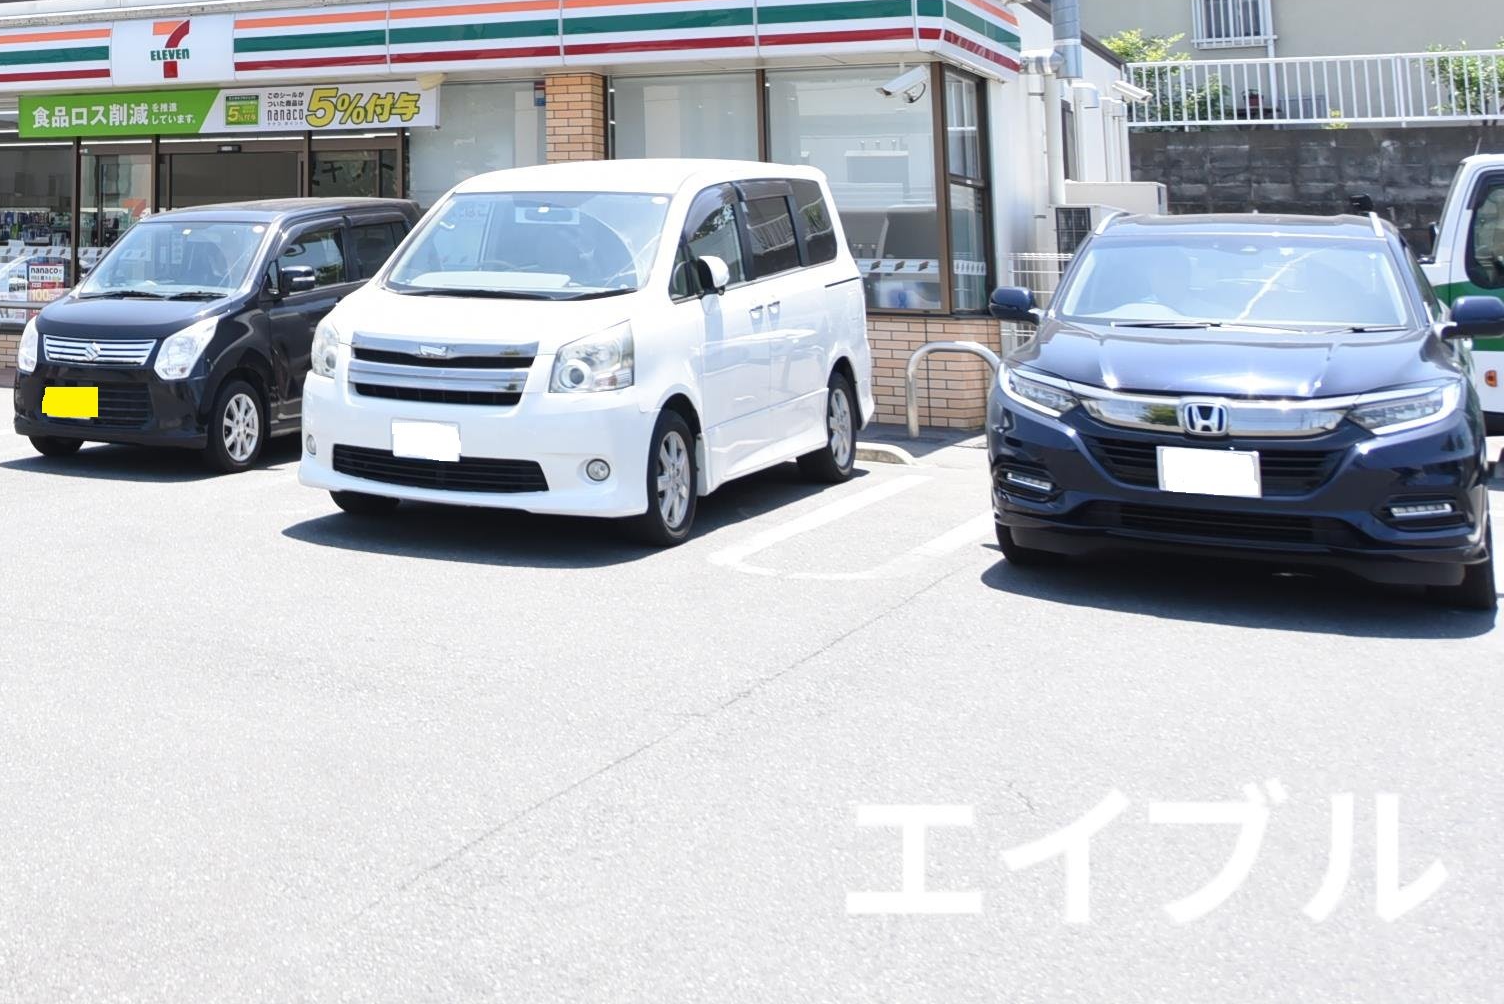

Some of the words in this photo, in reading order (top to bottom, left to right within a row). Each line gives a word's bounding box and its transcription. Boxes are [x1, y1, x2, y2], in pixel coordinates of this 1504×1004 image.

[267, 91, 305, 99] このシールが
[151, 102, 177, 113] を推進
[267, 100, 305, 108] ついた商品は
[305, 87, 421, 128] 5%付与
[32, 103, 149, 128] 食品ロス削減
[151, 114, 196, 125] しています。
[267, 108, 304, 121] nanaco
[30, 267, 59, 275] nanaco
